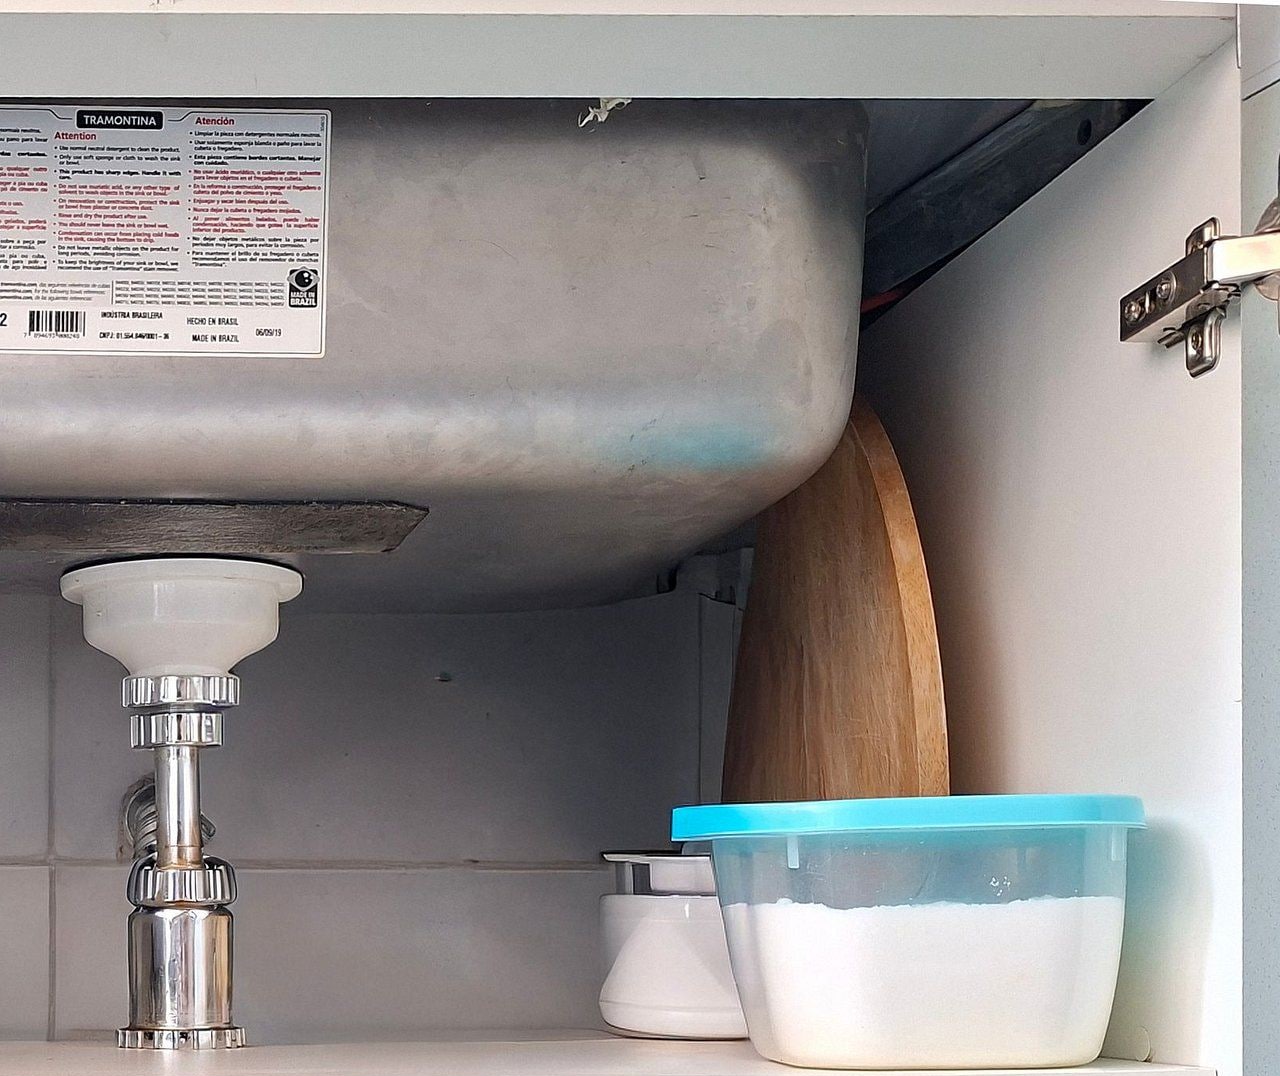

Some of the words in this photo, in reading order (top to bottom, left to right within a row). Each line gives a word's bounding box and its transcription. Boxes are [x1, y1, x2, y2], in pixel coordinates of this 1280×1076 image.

[83, 116, 156, 126] TRAMONTINA
[195, 116, 234, 125] Atención
[54, 132, 96, 140] Attention
